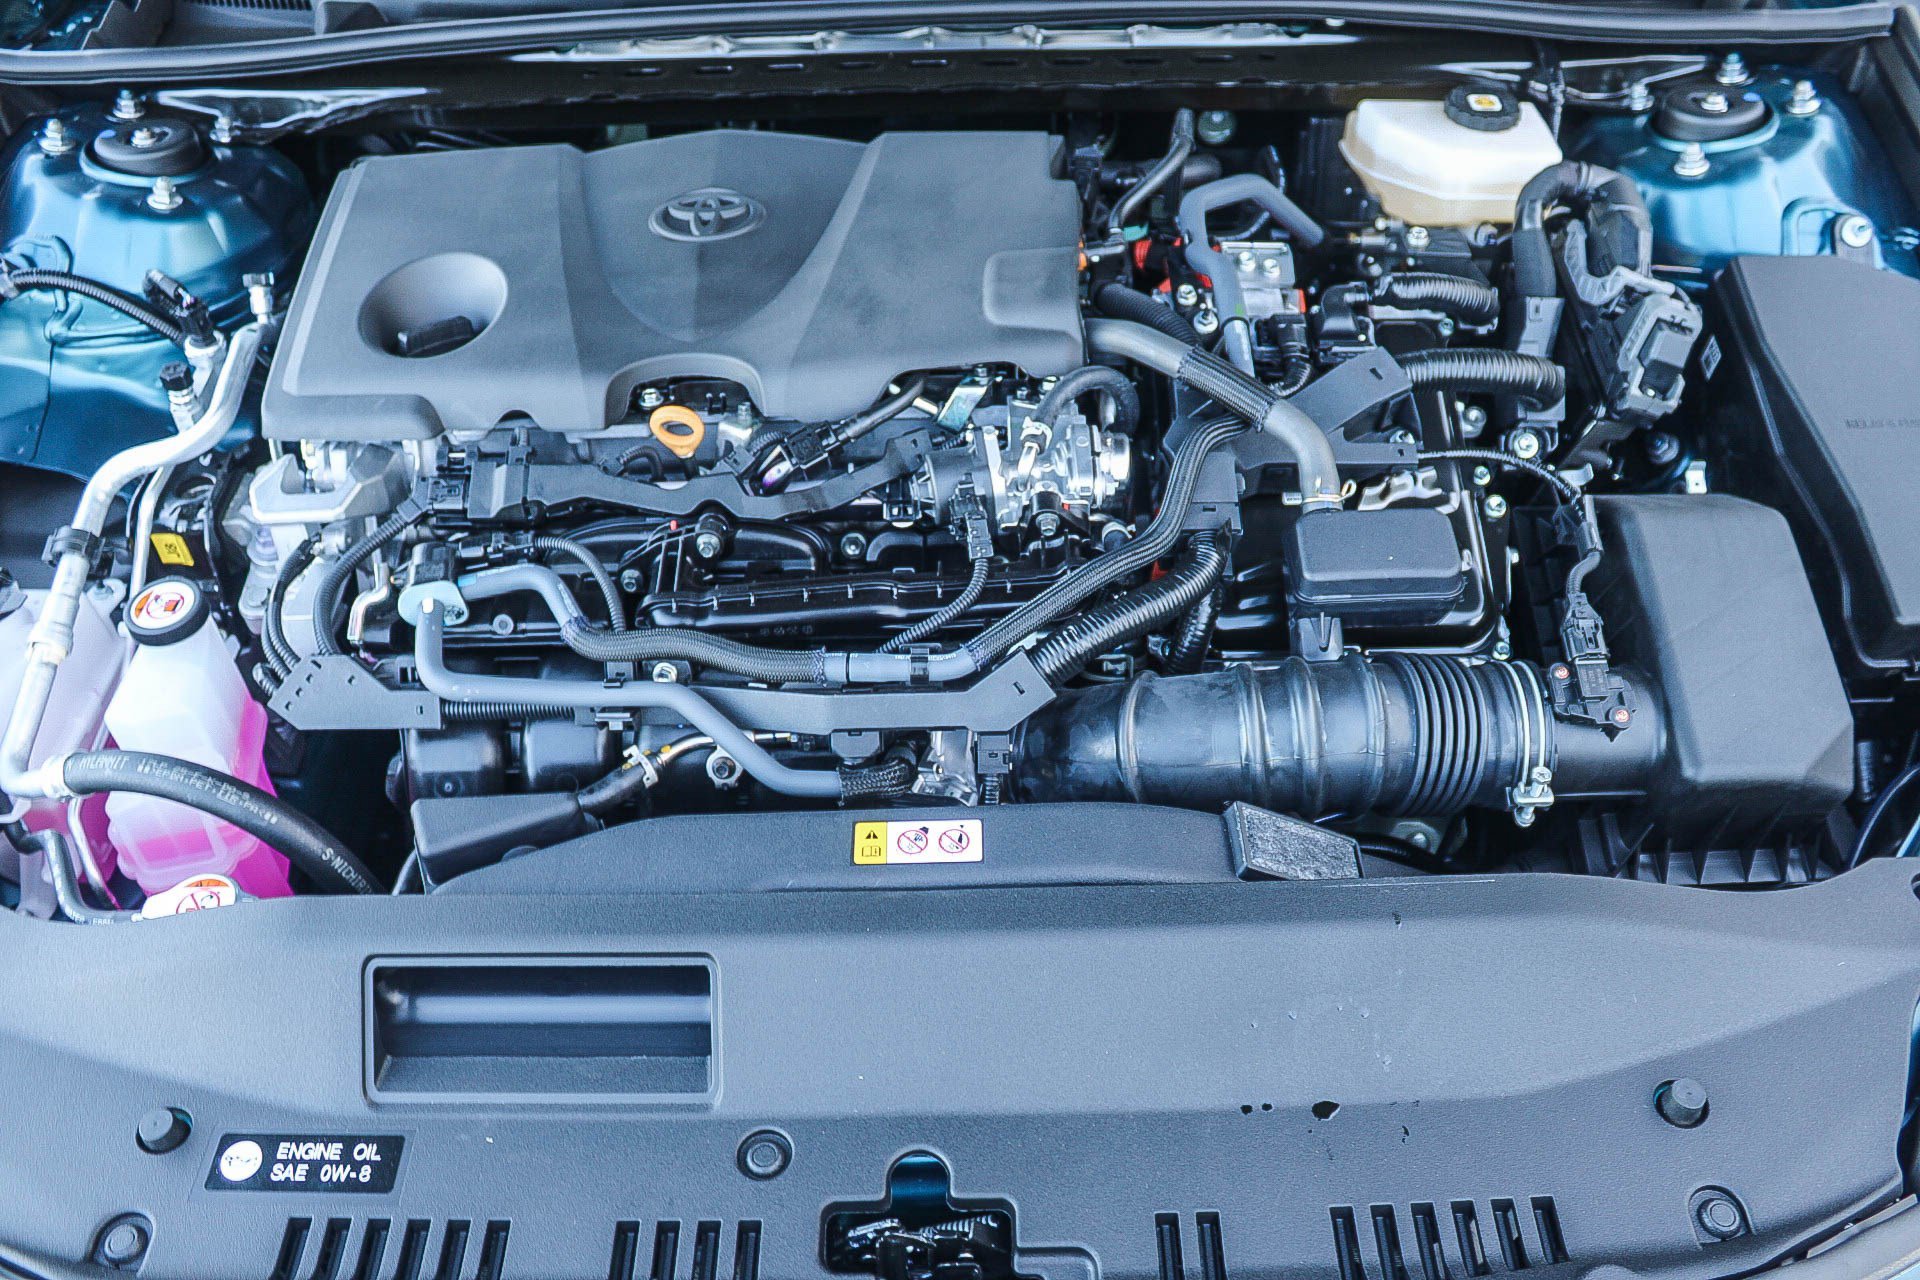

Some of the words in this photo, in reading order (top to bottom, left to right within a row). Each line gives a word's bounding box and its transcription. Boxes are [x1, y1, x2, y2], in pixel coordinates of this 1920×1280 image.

[276, 1141, 343, 1161] ENGINE
[353, 1142, 382, 1162] OIL
[270, 1162, 309, 1182] SAE
[319, 1163, 372, 1183] 0W-8
